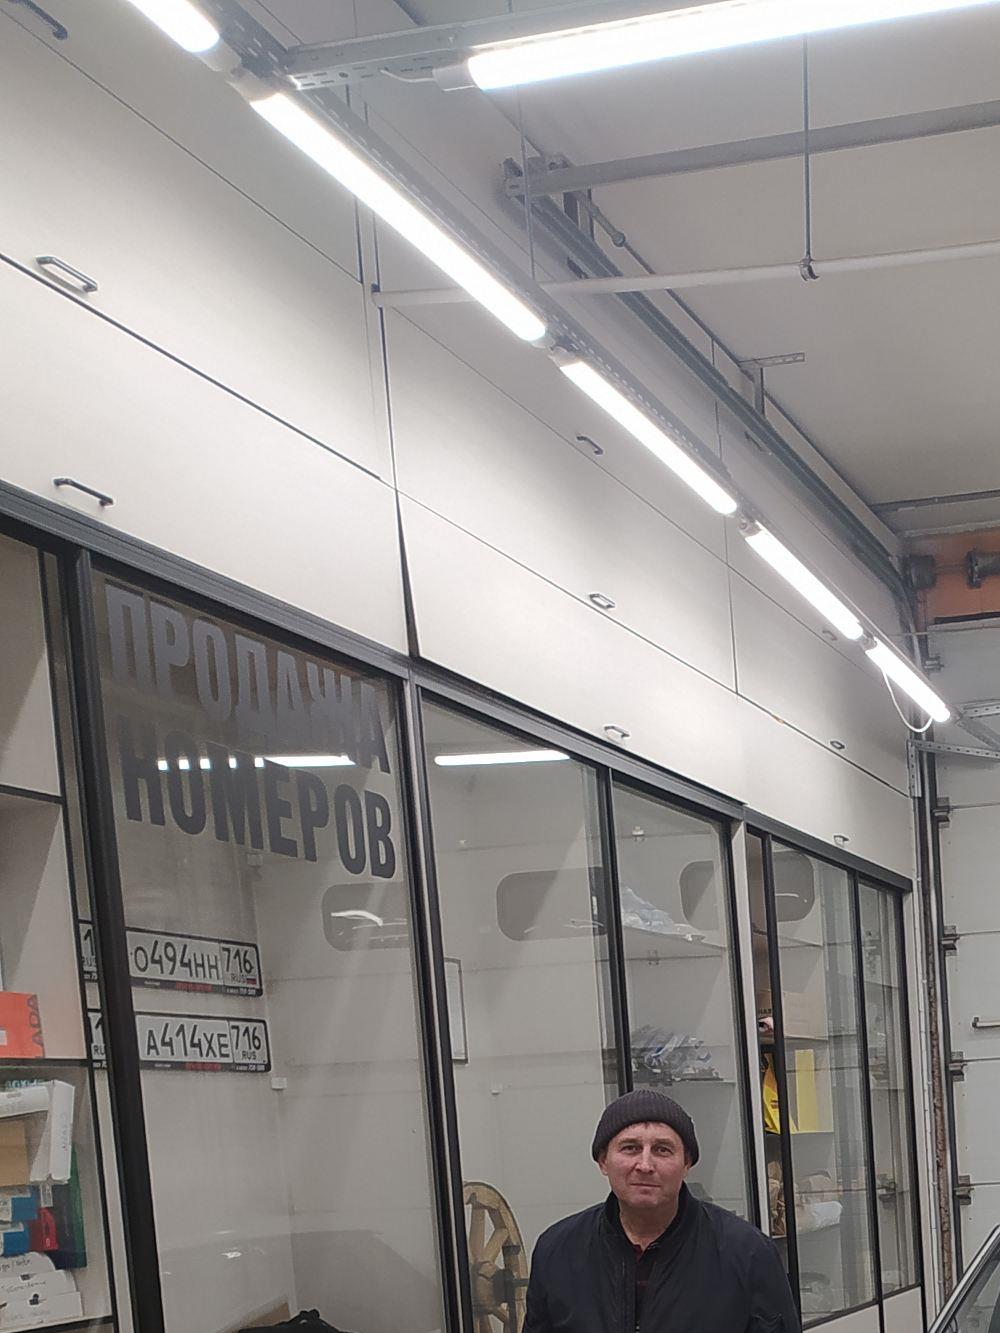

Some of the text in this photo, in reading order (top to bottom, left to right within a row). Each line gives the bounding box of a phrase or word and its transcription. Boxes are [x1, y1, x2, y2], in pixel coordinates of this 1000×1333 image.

[105, 581, 390, 774] ПРОДАЖА
[120, 715, 396, 879] НОМЕРОВ
[134, 940, 254, 980] О494НН 716
[147, 1022, 261, 1058] А414ХЕ 716
[242, 1051, 256, 1060] RUS
